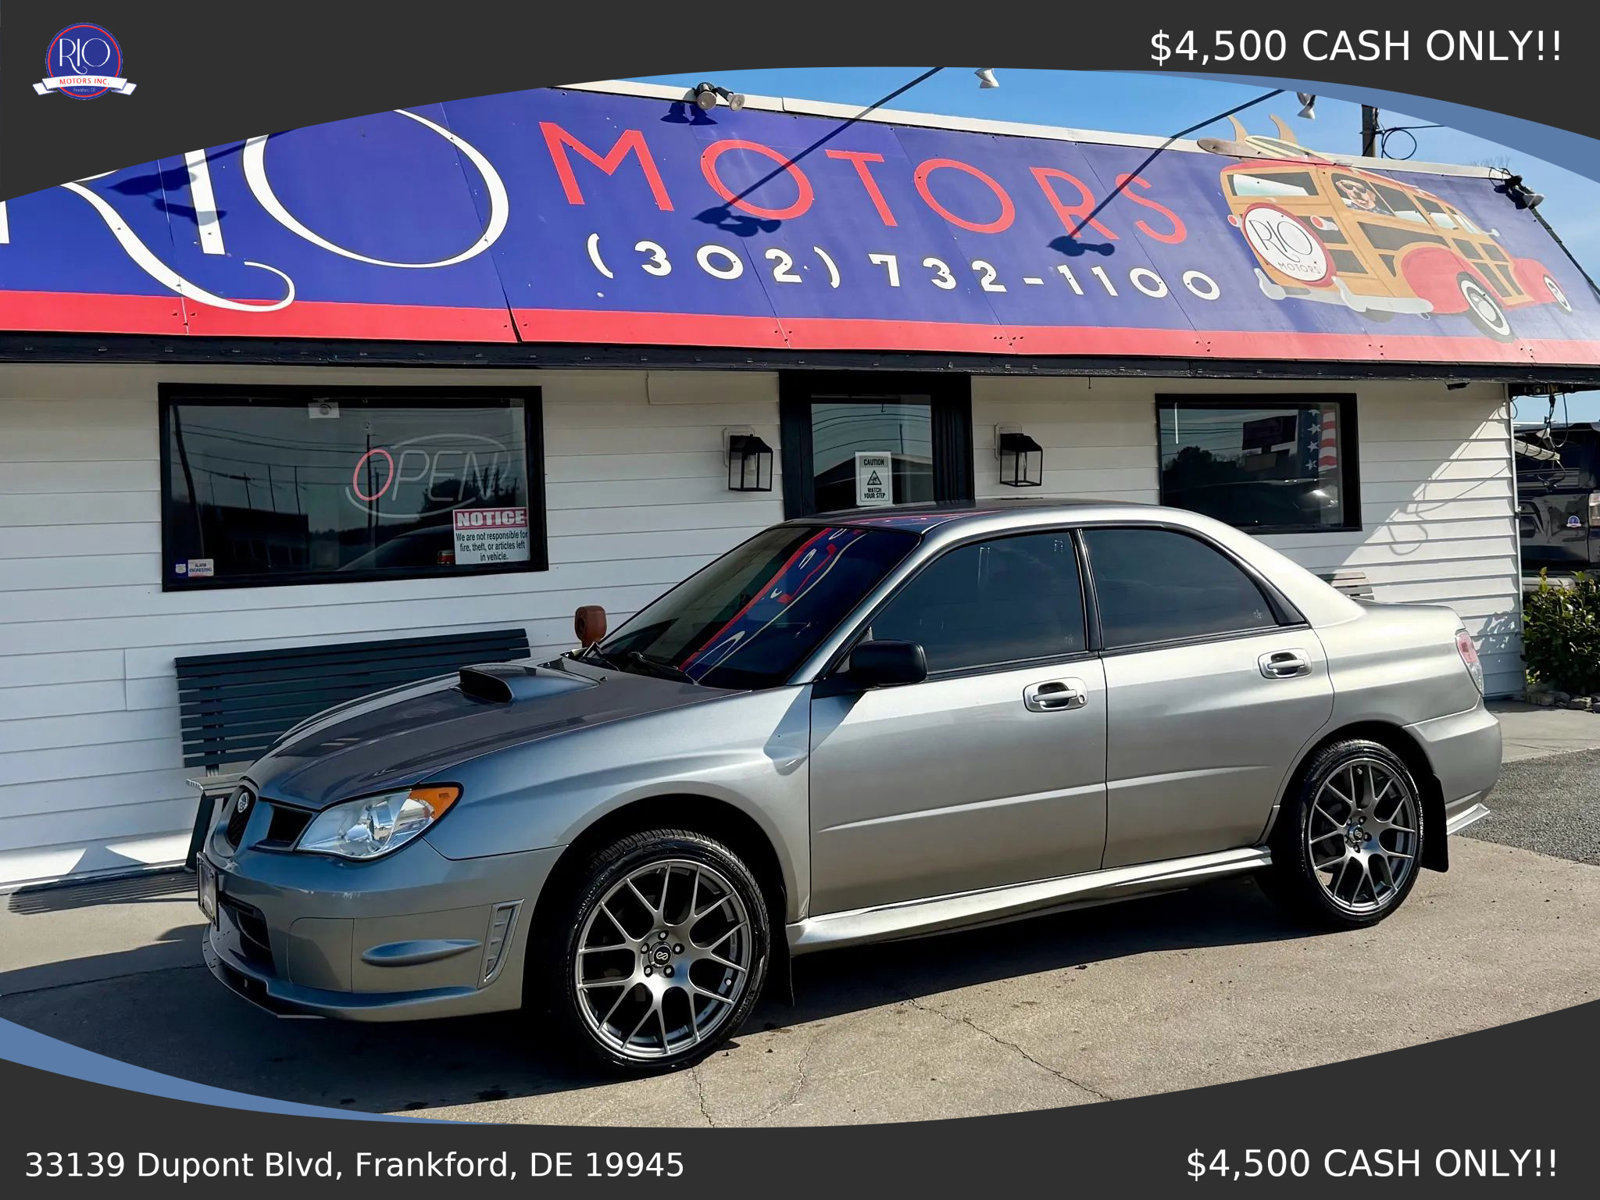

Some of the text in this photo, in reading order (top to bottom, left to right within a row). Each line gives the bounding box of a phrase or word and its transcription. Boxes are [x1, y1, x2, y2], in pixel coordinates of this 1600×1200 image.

[539, 121, 1188, 245] MOTORS
[1248, 219, 1313, 263] RIO
[586, 232, 1221, 301] (302) 732-1100
[1278, 262, 1321, 275] MOTORS
[863, 458, 885, 466] CAUTION
[353, 449, 502, 501] OPEN
[456, 511, 525, 527] NOTICE
[456, 533, 465, 542] We
[476, 532, 486, 541] not
[486, 531, 520, 542] responsible
[520, 530, 529, 538] for
[495, 541, 516, 550] articles
[516, 540, 526, 549] left
[480, 552, 486, 561] in
